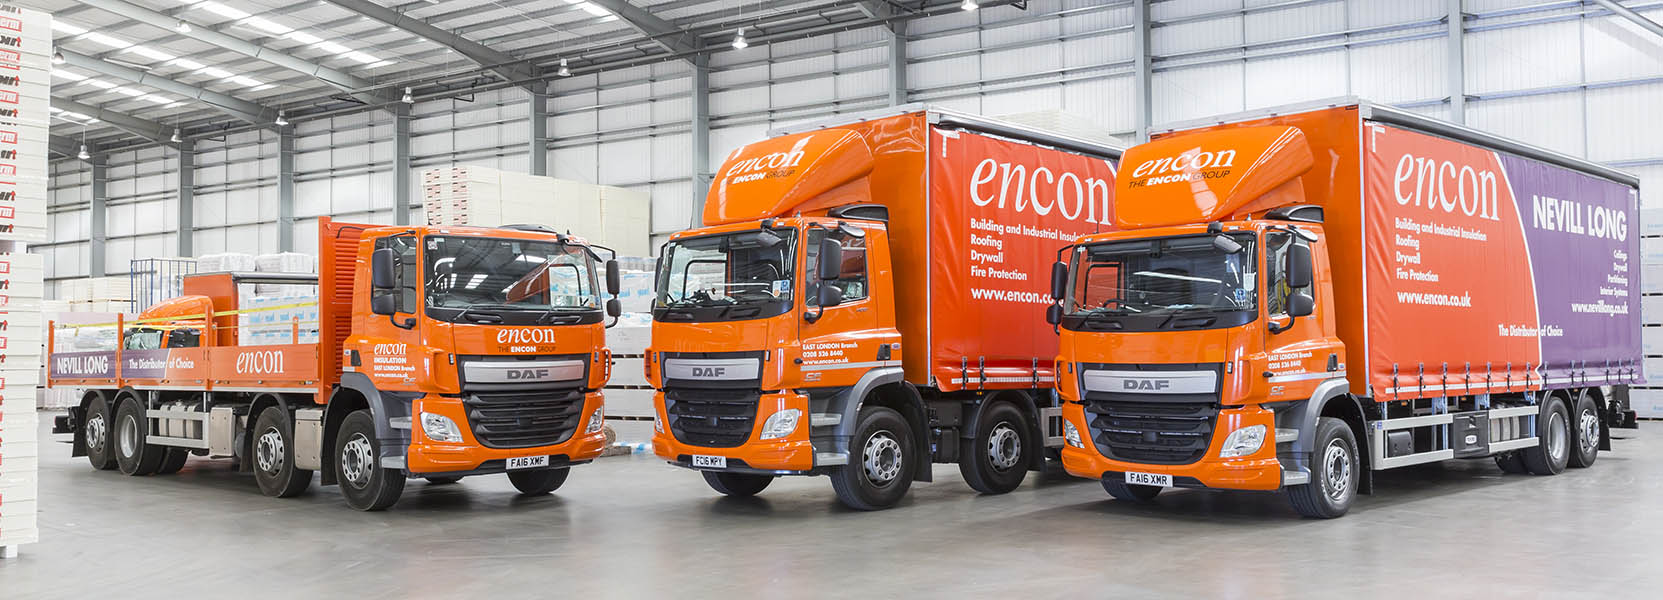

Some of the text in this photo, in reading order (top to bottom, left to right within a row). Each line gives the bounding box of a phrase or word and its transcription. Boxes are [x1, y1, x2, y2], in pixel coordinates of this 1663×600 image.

[726, 150, 805, 177] encon
[1132, 149, 1236, 178] encon
[732, 172, 766, 184] ENCON
[1129, 170, 1230, 188] THE ENCON GROUP
[970, 158, 1112, 225] encon
[1394, 153, 1500, 221] encon
[1533, 194, 1627, 242] NEVILL LONG
[970, 218, 1004, 235] Building
[1005, 224, 1021, 235] and
[1023, 225, 1058, 240] Industrial
[1395, 217, 1487, 241] Building and Industrial Insulation
[970, 234, 1003, 250] Roofing
[1395, 234, 1420, 251] Roofing
[970, 250, 1004, 265] Drywall
[1396, 251, 1421, 267] Drywall
[970, 266, 1028, 281] Fire Protection
[1396, 267, 1440, 283] Fire Protection
[1397, 291, 1472, 308] www.encon.co.uk
[496, 327, 556, 344] encon
[1498, 324, 1564, 337] The Distributor of Choice
[374, 343, 407, 355] encon
[57, 355, 109, 374] NEVILL LONG
[128, 357, 194, 369] The Distributor of Choice
[236, 350, 284, 374] encon
[507, 369, 549, 380] DAF
[692, 367, 726, 377] DAF
[1123, 379, 1170, 391] DAF
[510, 456, 545, 468] FA16 XMF
[1130, 473, 1168, 485] FA16 XMR
